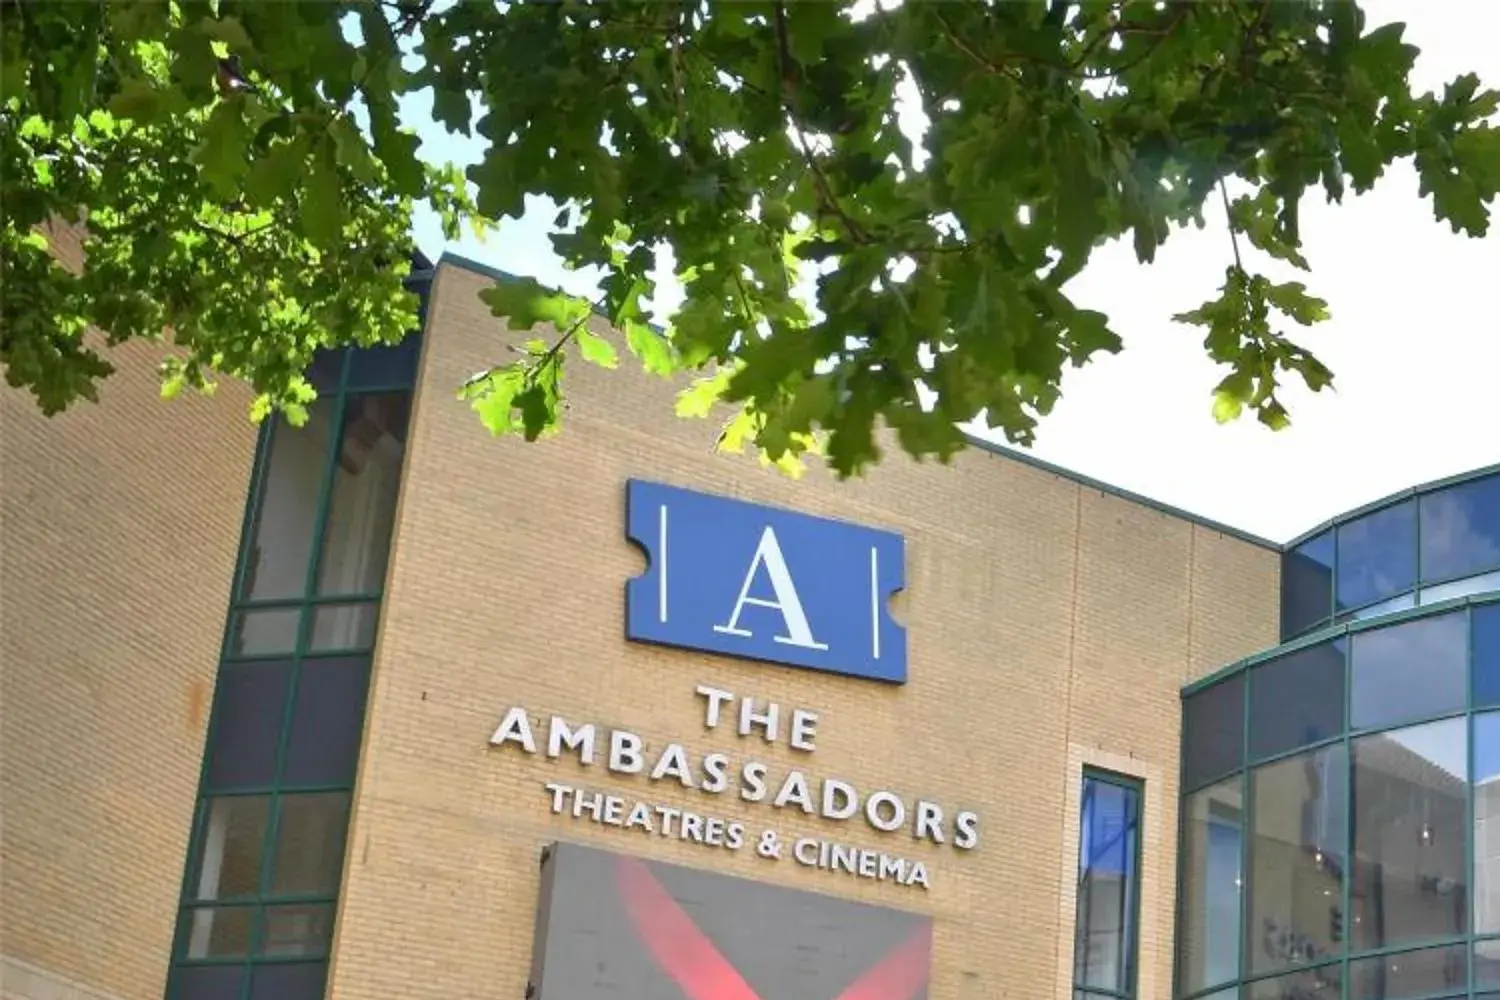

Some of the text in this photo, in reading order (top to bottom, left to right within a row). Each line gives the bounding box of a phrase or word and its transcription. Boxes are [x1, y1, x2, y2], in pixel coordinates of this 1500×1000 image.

[712, 525, 829, 651] A
[696, 684, 820, 752] THE
[489, 706, 980, 852] AMBASSADORS
[545, 782, 932, 890] THEATRES & CINEMA
